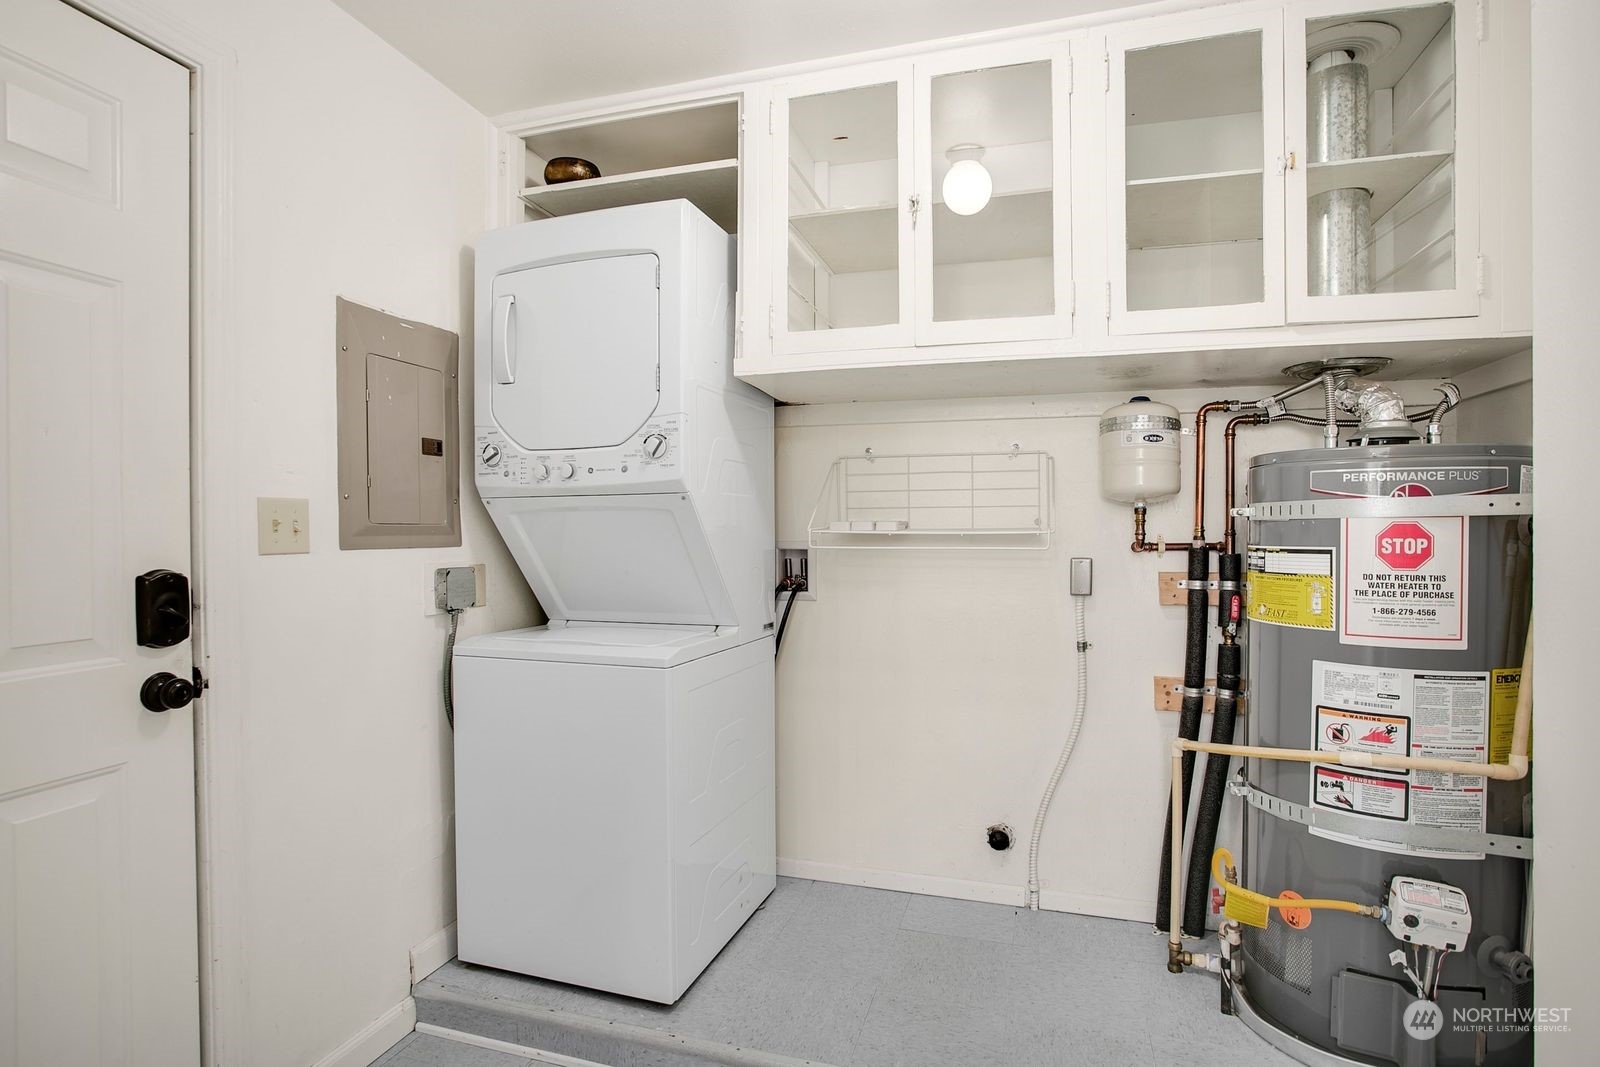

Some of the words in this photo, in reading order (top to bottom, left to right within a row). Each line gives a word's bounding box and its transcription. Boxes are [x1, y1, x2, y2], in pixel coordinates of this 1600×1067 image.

[1343, 471, 1445, 482] PERFORMANCE
[1381, 537, 1428, 555] STOP
[1362, 573, 1374, 581] DO
[1394, 574, 1426, 582] RETURN
[1354, 589, 1369, 597] THE
[1371, 590, 1397, 598] PLACE
[1413, 591, 1454, 599] PURCHASE
[1372, 607, 1437, 616] 1-866-279-4566
[1349, 713, 1382, 722] WARNING
[1350, 776, 1377, 785] DANGER
